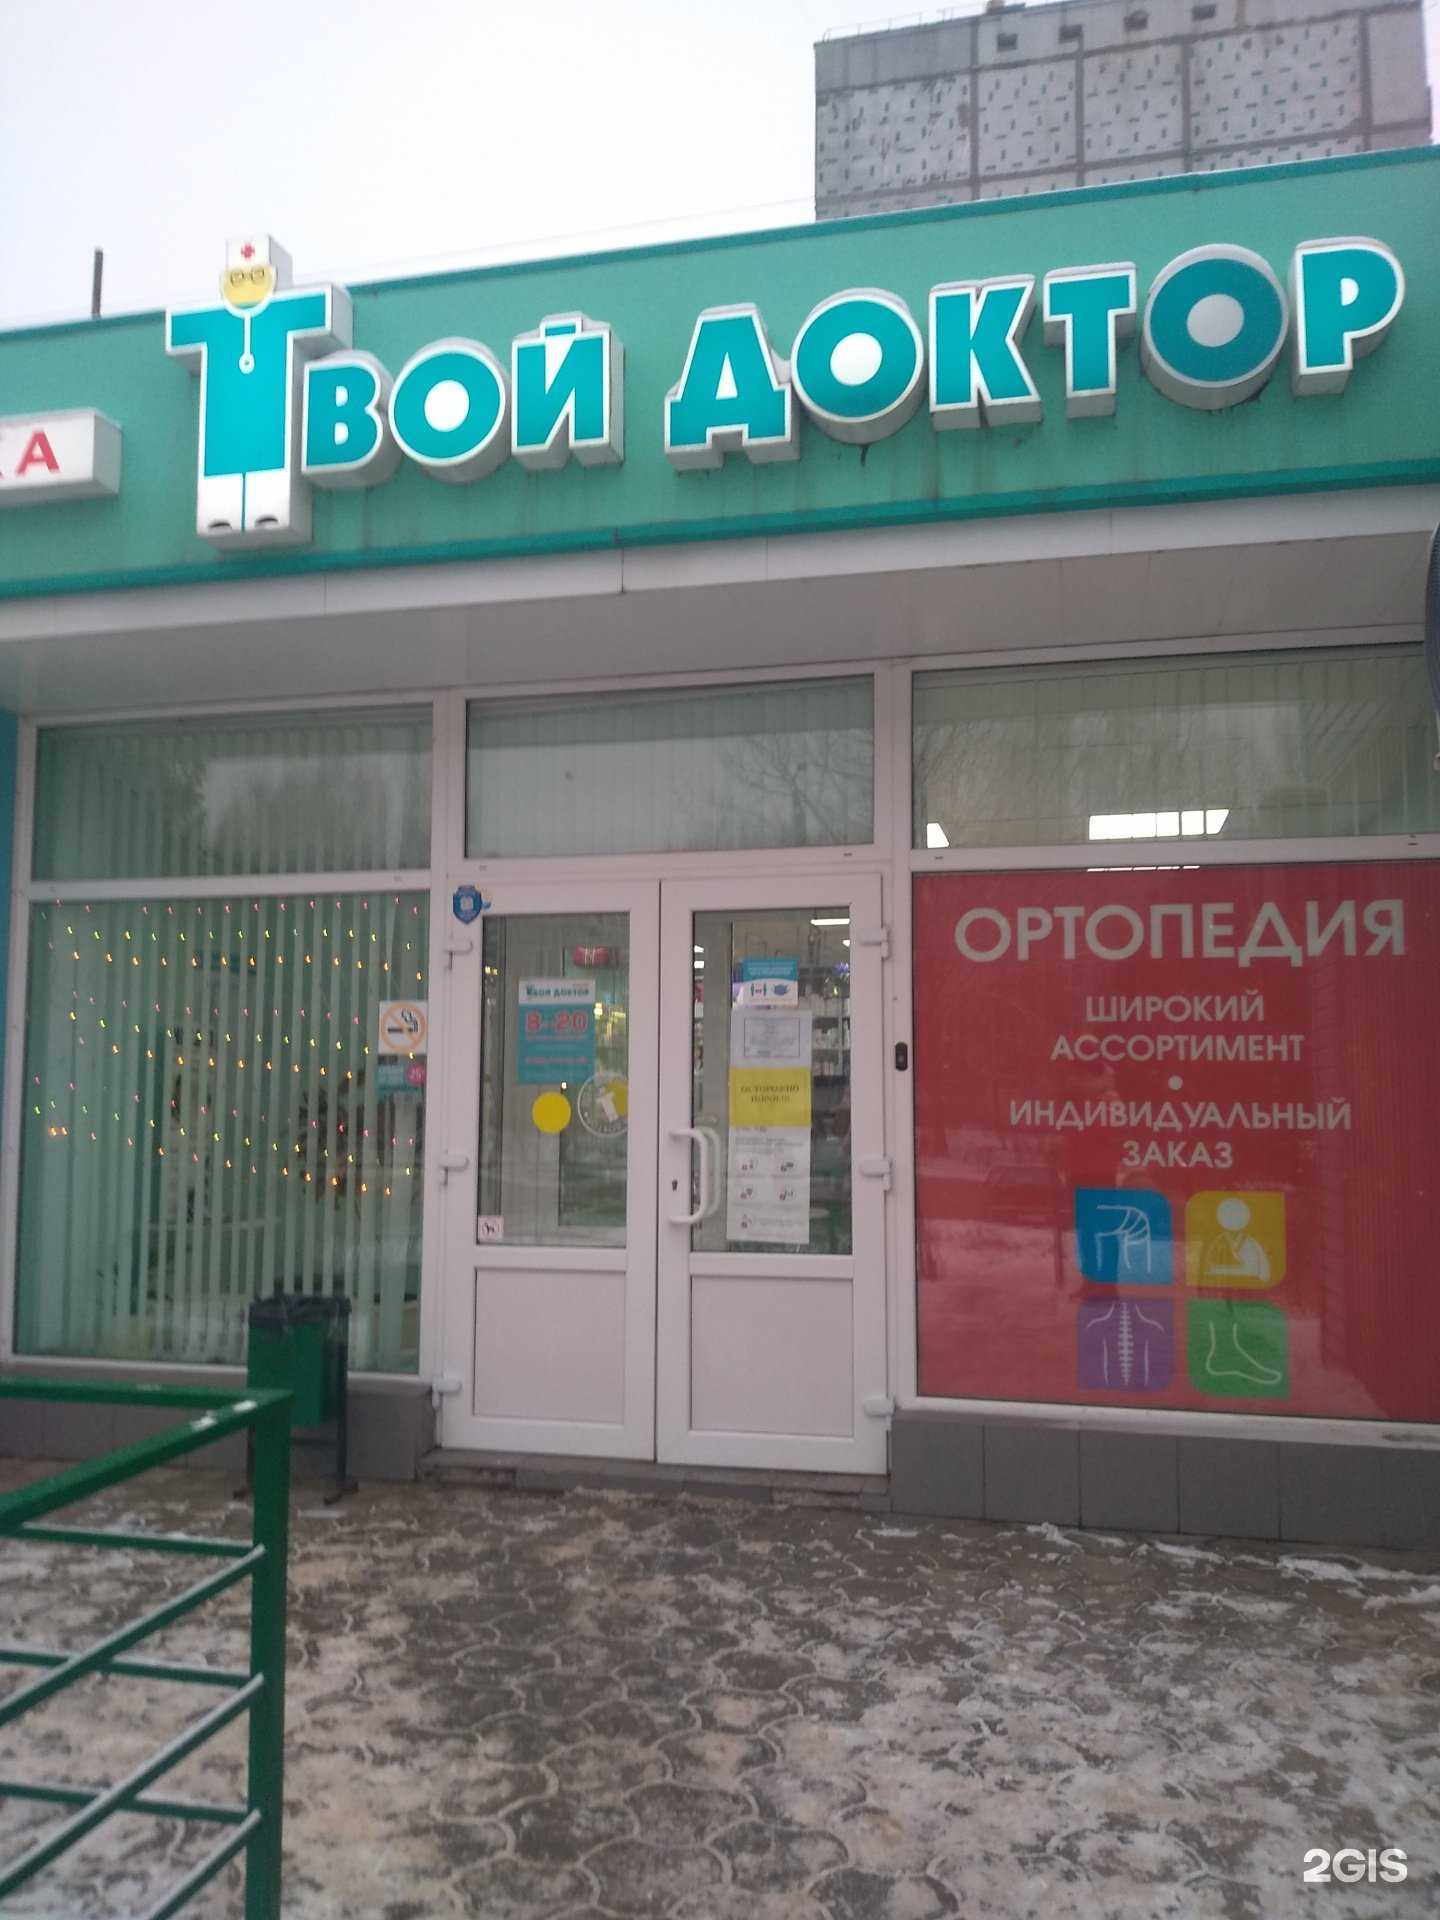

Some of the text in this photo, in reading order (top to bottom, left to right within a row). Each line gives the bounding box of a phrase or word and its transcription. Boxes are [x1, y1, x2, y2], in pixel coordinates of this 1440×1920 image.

[664, 236, 1406, 456] ДОКТОР
[953, 898, 1406, 968] ОРТОПЕДИЯ
[1085, 988, 1265, 1023] ШИРОКИЙ
[1049, 1033, 1305, 1062] АССОРТИМЕНТ
[1009, 1096, 1353, 1133] ИНДИВИДУАЛЬНЫЙ
[1121, 1140, 1234, 1169] ЗАКАЗ
